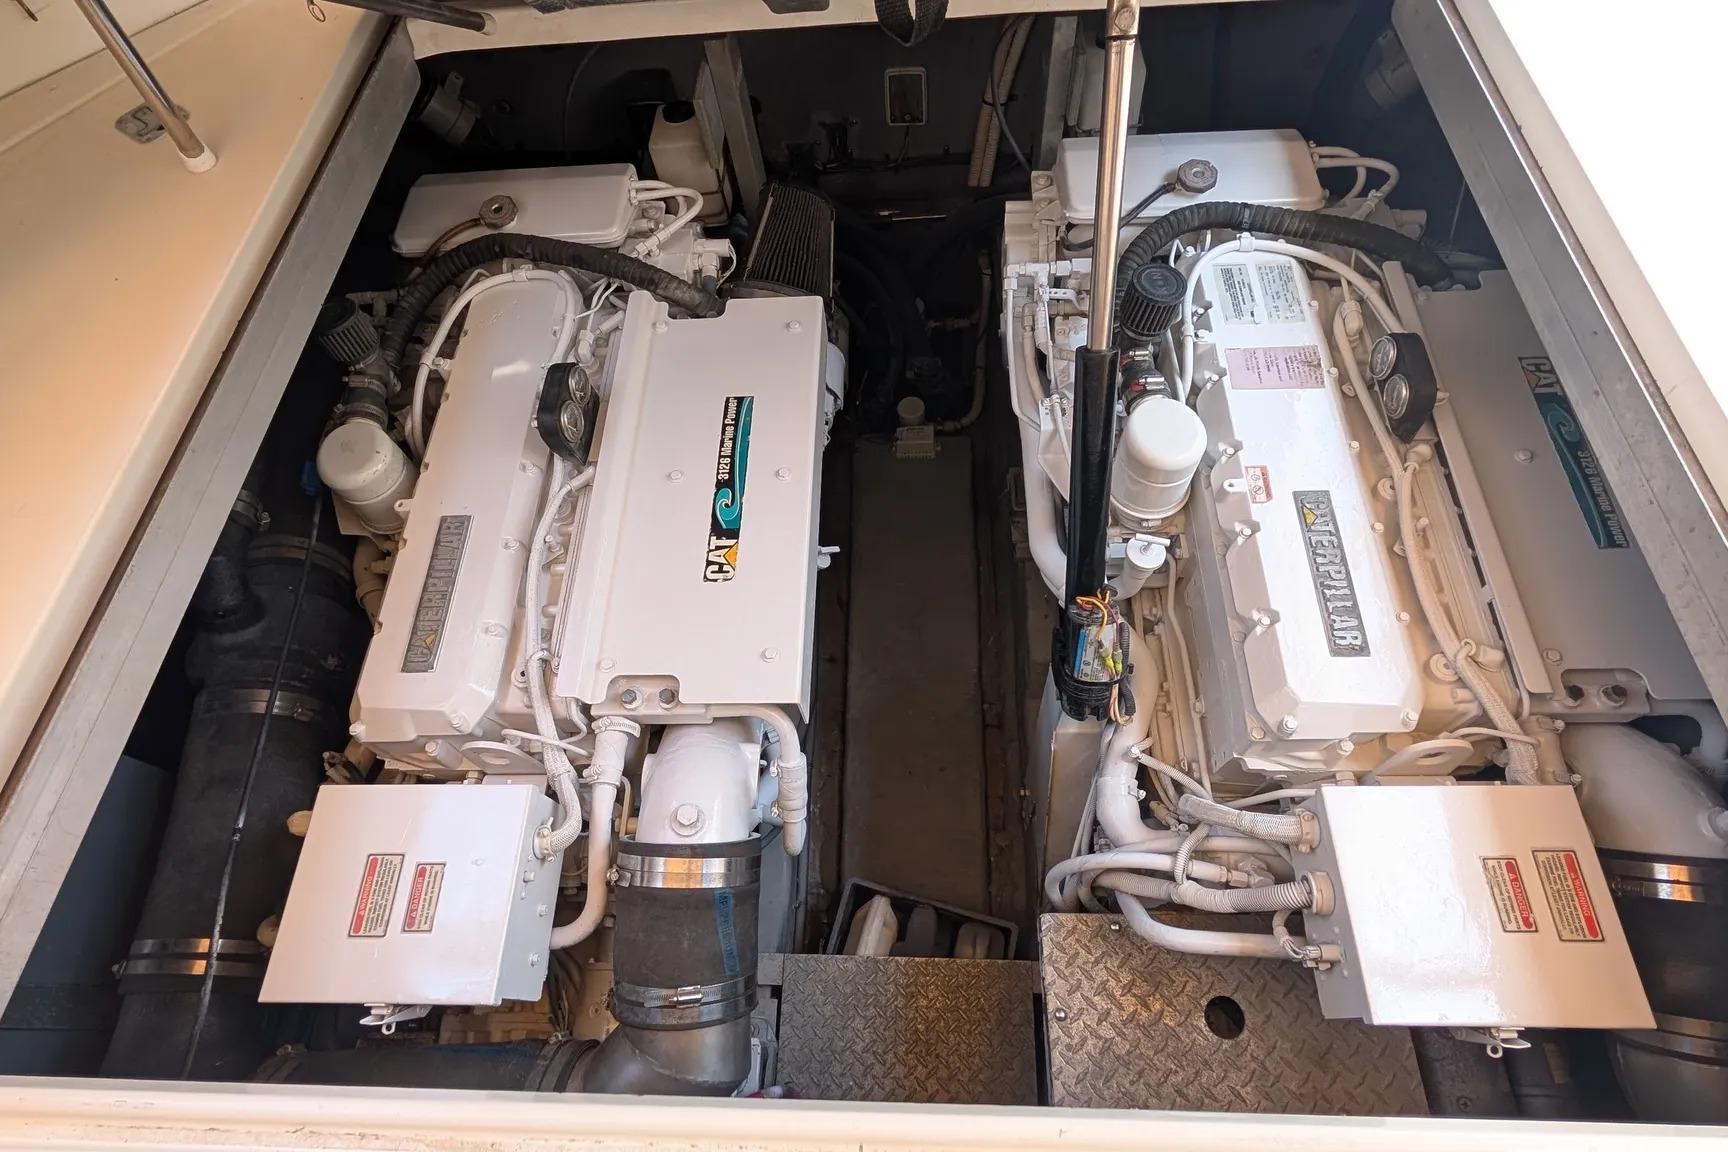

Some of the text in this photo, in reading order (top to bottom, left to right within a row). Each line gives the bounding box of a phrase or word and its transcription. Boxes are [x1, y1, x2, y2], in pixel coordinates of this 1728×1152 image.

[705, 397, 737, 579] CAT 3126 Marine Power
[1519, 358, 1563, 396] CAT
[1588, 476, 1612, 511] Marine
[1603, 513, 1627, 547] Power
[404, 517, 467, 662] CATERPILLAR
[1298, 493, 1364, 652] CATERPILLAR
[359, 875, 372, 910] WARNING
[411, 877, 423, 908] DANGER
[1511, 881, 1529, 916] DANGER
[1570, 878, 1592, 916] WARNING
